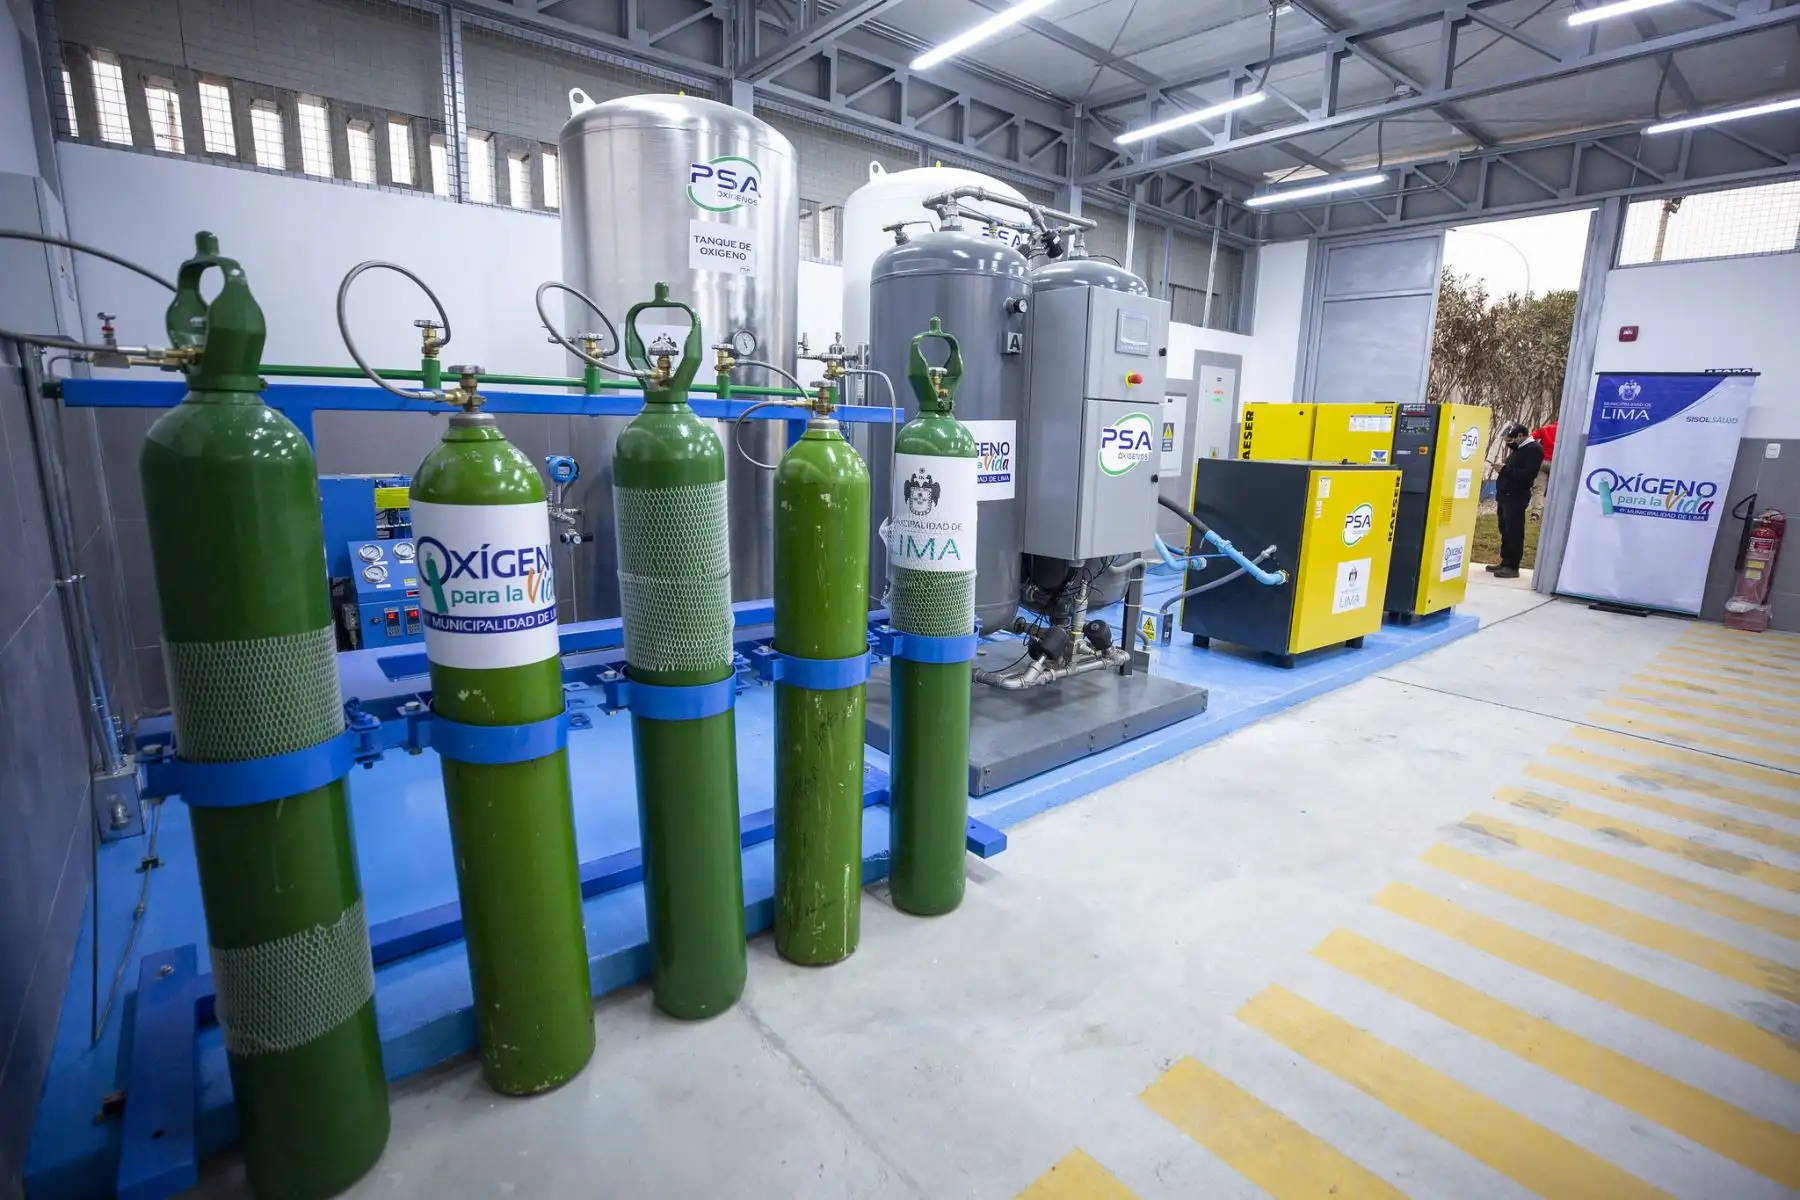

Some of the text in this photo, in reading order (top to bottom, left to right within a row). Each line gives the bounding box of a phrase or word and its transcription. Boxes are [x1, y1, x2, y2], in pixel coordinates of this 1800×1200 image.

[691, 164, 761, 198] PSA
[694, 235, 752, 252] TANQUE DE
[700, 247, 746, 261] OXIGENO
[1009, 334, 1020, 350] A
[1601, 408, 1649, 420] LIMA
[1101, 428, 1151, 450] PSA
[1242, 410, 1254, 460] AESER
[1461, 434, 1478, 447] PSA
[1586, 468, 1717, 498] OXÍGENO
[1618, 489, 1714, 514] para la Vida
[1345, 514, 1371, 529] PSA
[416, 536, 553, 587] OXÍGEN
[451, 589, 499, 608] para
[506, 585, 523, 602] la
[432, 615, 535, 632] MUNICIPALIDAD
[537, 611, 550, 625] DE
